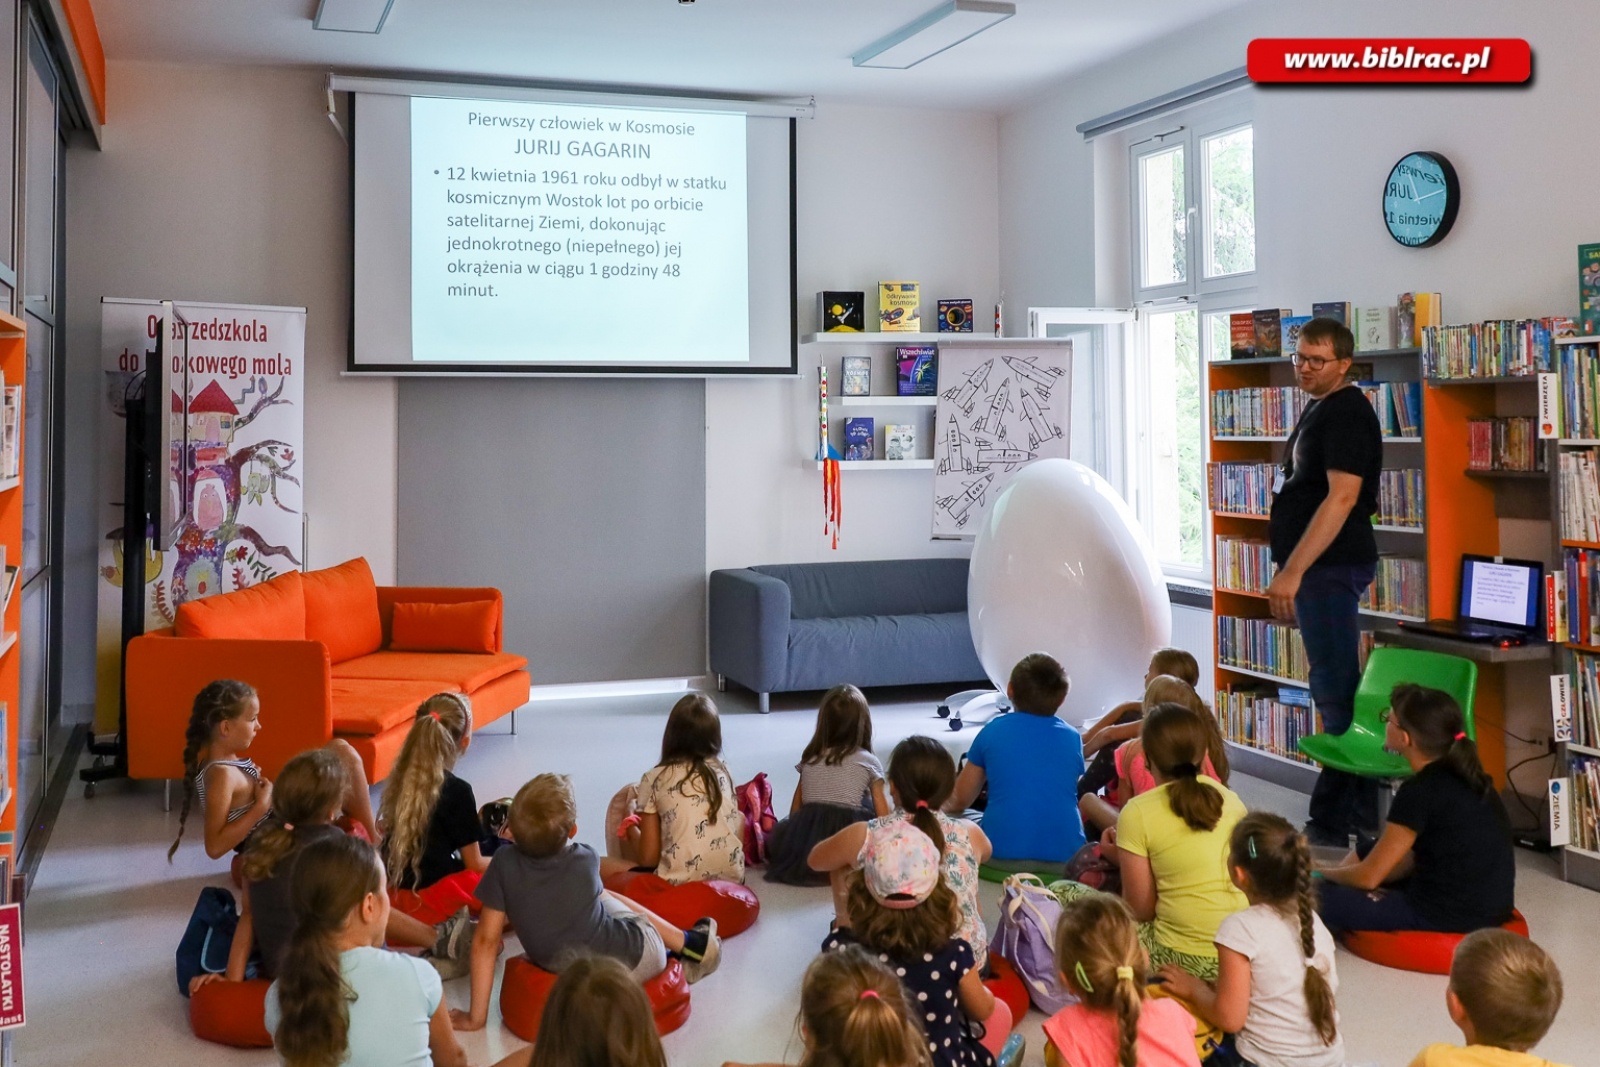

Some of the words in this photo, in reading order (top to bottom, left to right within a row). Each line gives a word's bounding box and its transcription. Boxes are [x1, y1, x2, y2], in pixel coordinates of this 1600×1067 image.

[468, 111, 535, 132] Pierwszy
[539, 114, 604, 132] człowiek
[608, 122, 622, 132] w
[626, 119, 695, 136] Kosmosie
[514, 138, 561, 156] JURIJ
[567, 141, 651, 159] GAGARIN
[447, 166, 466, 181] 12
[471, 166, 537, 183] kwietnia
[542, 170, 578, 185] 1961
[583, 171, 617, 186] roku
[621, 173, 663, 191] odbył
[667, 178, 680, 188] w
[684, 176, 727, 191] statku
[447, 188, 542, 209] kosmicznym
[546, 193, 603, 208] Wostok
[607, 194, 627, 209] lot
[631, 200, 651, 213] po
[654, 197, 704, 212] orbicie
[446, 213, 534, 232] satelitarnej
[538, 216, 585, 232] Ziemi,
[589, 216, 666, 236] dokonując
[446, 236, 562, 256] jednokrotnego
[566, 238, 660, 258] (niepełnego)
[664, 241, 682, 258] jej
[447, 259, 522, 278] okrążenia
[526, 264, 540, 275] w
[544, 262, 584, 279] ciągu
[589, 263, 598, 276] 1
[601, 262, 659, 280] godziny
[662, 264, 681, 278] 48
[447, 282, 499, 297] minut.
[188, 317, 268, 342] zedszkola
[118, 347, 139, 372] do
[252, 352, 292, 376] mola
[899, 348, 935, 356] Wszechświat
[1558, 676, 1567, 718] CZŁOWIEK
[1552, 795, 1561, 831] ZIEMIA
[0, 923, 13, 1011] NASTOLATKI
